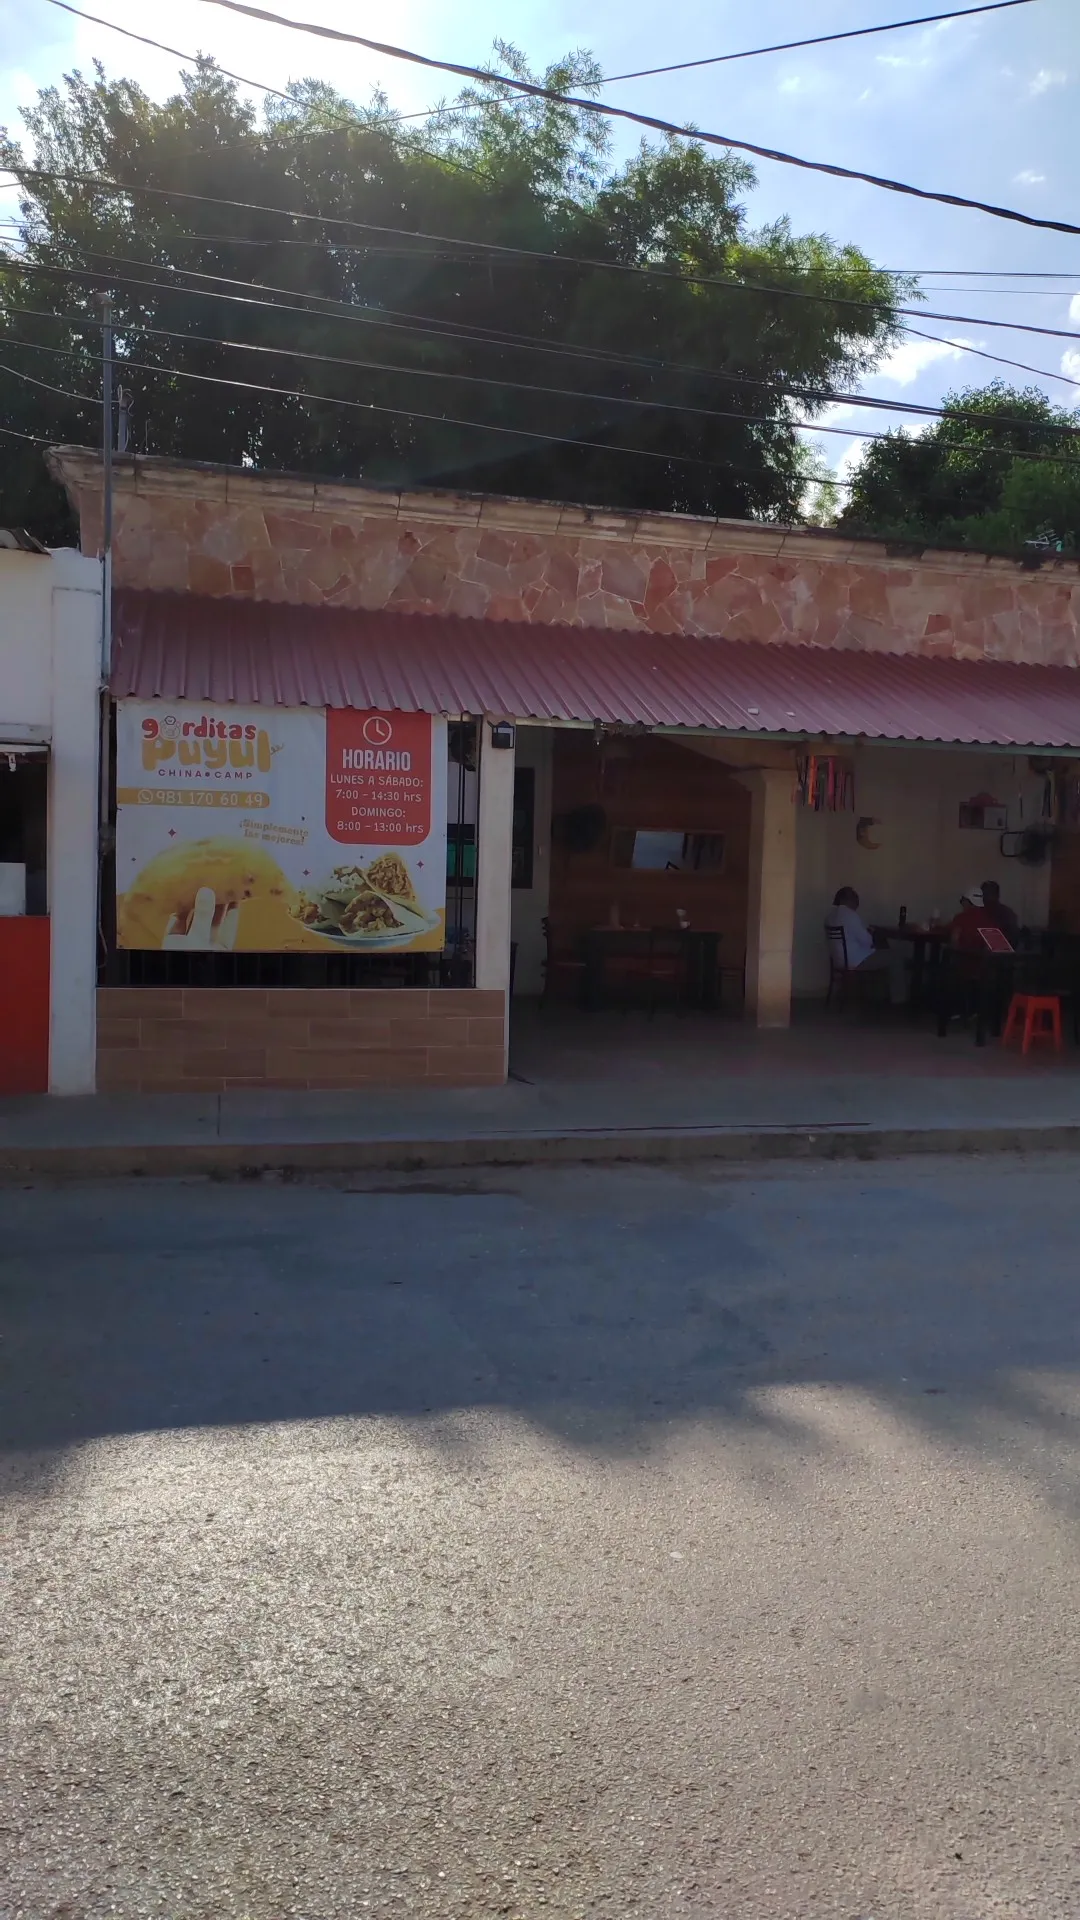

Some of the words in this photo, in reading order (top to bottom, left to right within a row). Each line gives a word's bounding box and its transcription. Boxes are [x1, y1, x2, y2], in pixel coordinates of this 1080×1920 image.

[342, 748, 411, 771] HORARIO
[330, 774, 364, 784] LUNES
[368, 776, 375, 785] A
[378, 775, 424, 787] SÁBADO:
[155, 790, 183, 804] 981
[189, 792, 214, 805] 170
[220, 793, 238, 806] 60
[245, 793, 263, 807] 49
[335, 789, 359, 799] 7:00
[371, 791, 400, 801] 14:30
[403, 793, 422, 802] hrs
[351, 806, 406, 818] DOMINGO:
[337, 821, 361, 831] 8:00
[373, 822, 402, 832] 13:00
[405, 823, 424, 833] hrs
